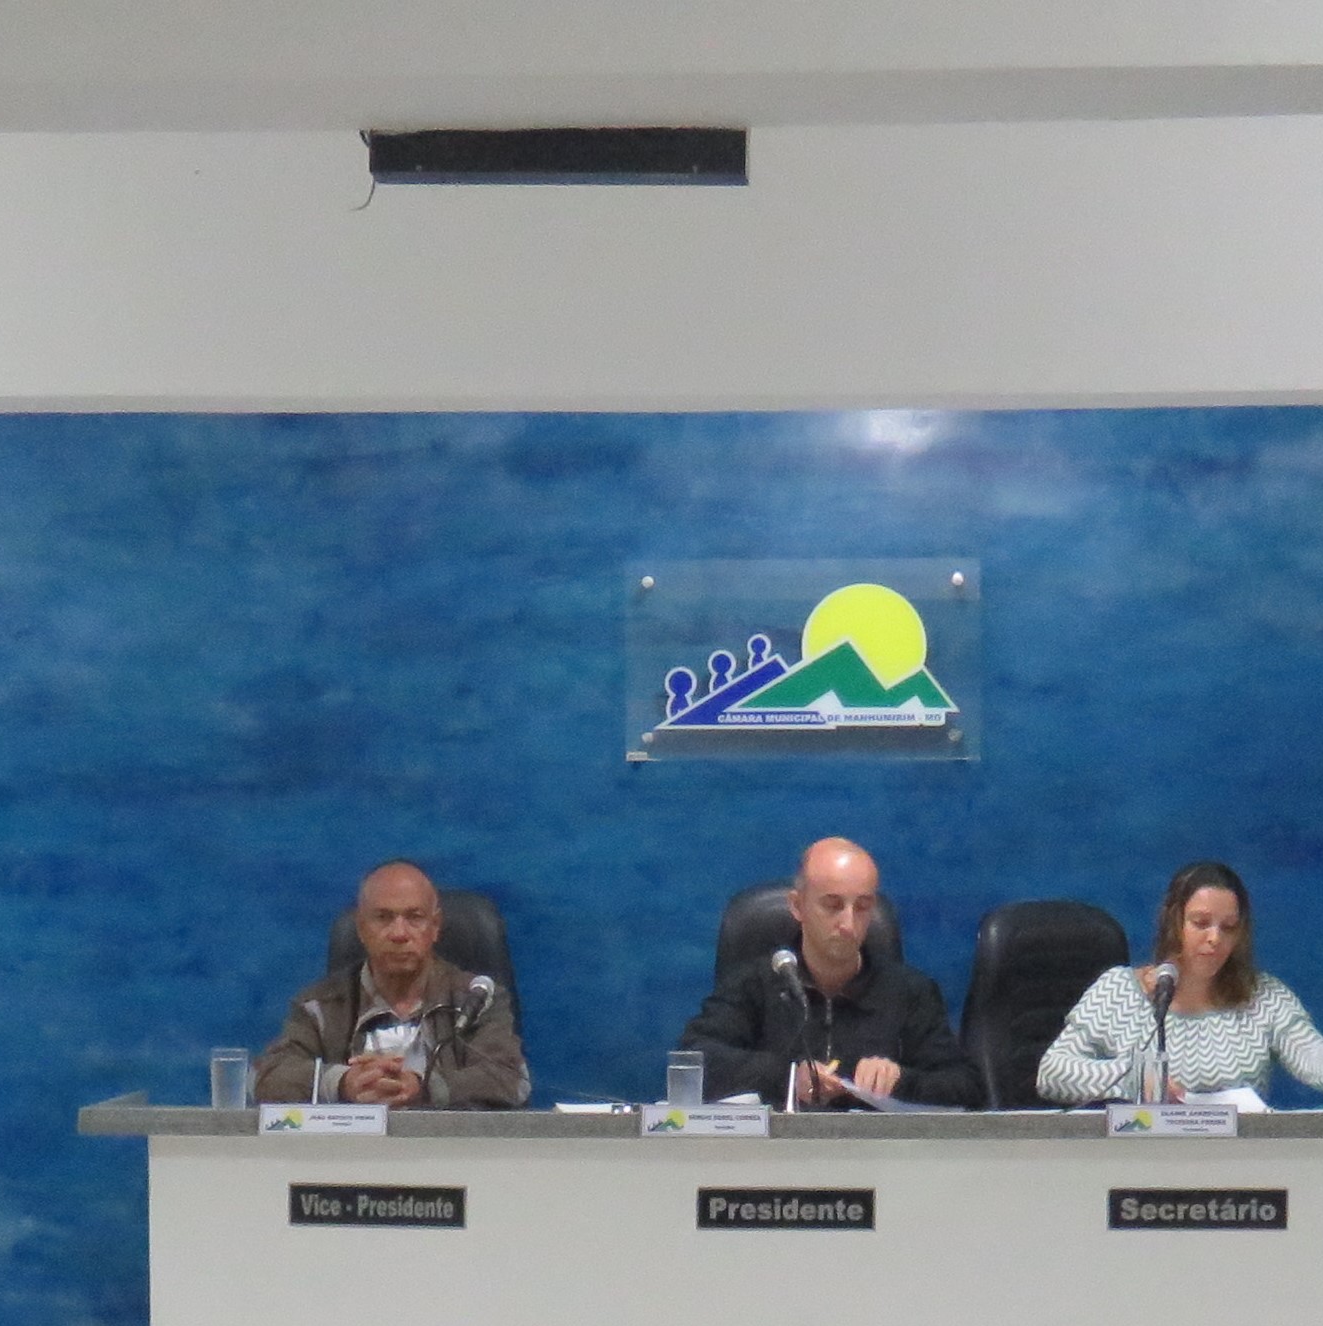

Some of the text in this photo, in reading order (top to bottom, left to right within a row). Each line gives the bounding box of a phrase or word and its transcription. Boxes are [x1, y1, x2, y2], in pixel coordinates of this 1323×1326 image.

[765, 712, 825, 724] MUNICIPAL
[300, 1193, 342, 1217] Vice
[357, 1194, 455, 1219] Presidente
[708, 1197, 865, 1222] Presidente
[1120, 1197, 1277, 1222] Secretário
